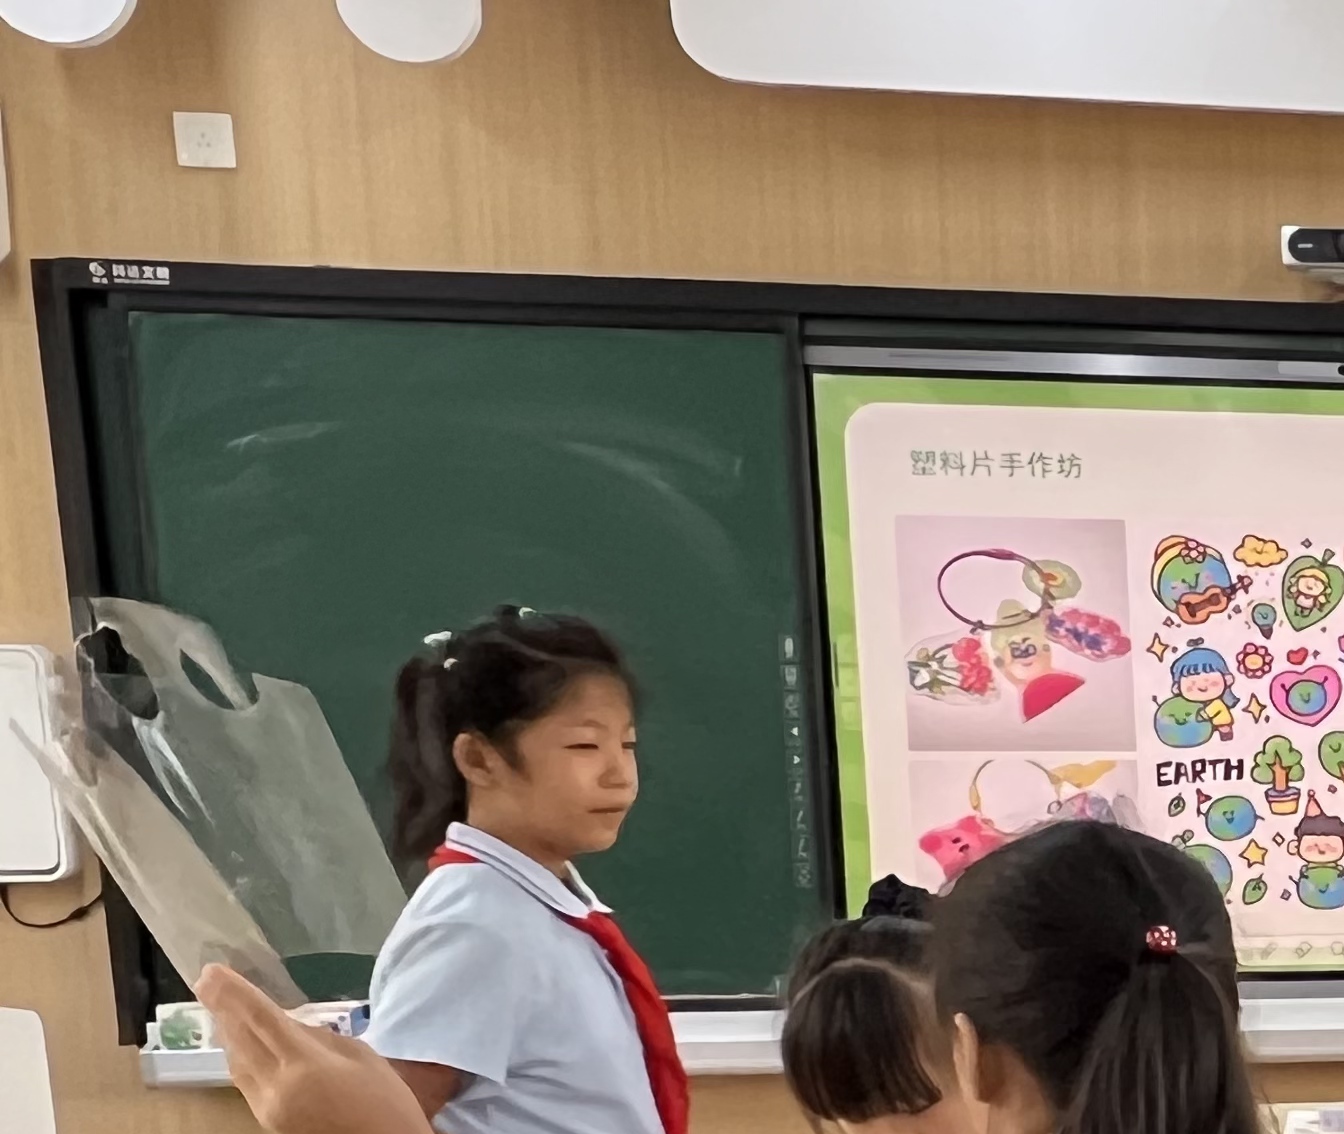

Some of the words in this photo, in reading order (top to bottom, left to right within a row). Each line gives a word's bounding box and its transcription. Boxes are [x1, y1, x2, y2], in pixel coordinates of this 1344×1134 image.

[910, 449, 1083, 479] 塑料片手作坊
[1155, 757, 1244, 787] EARTH
